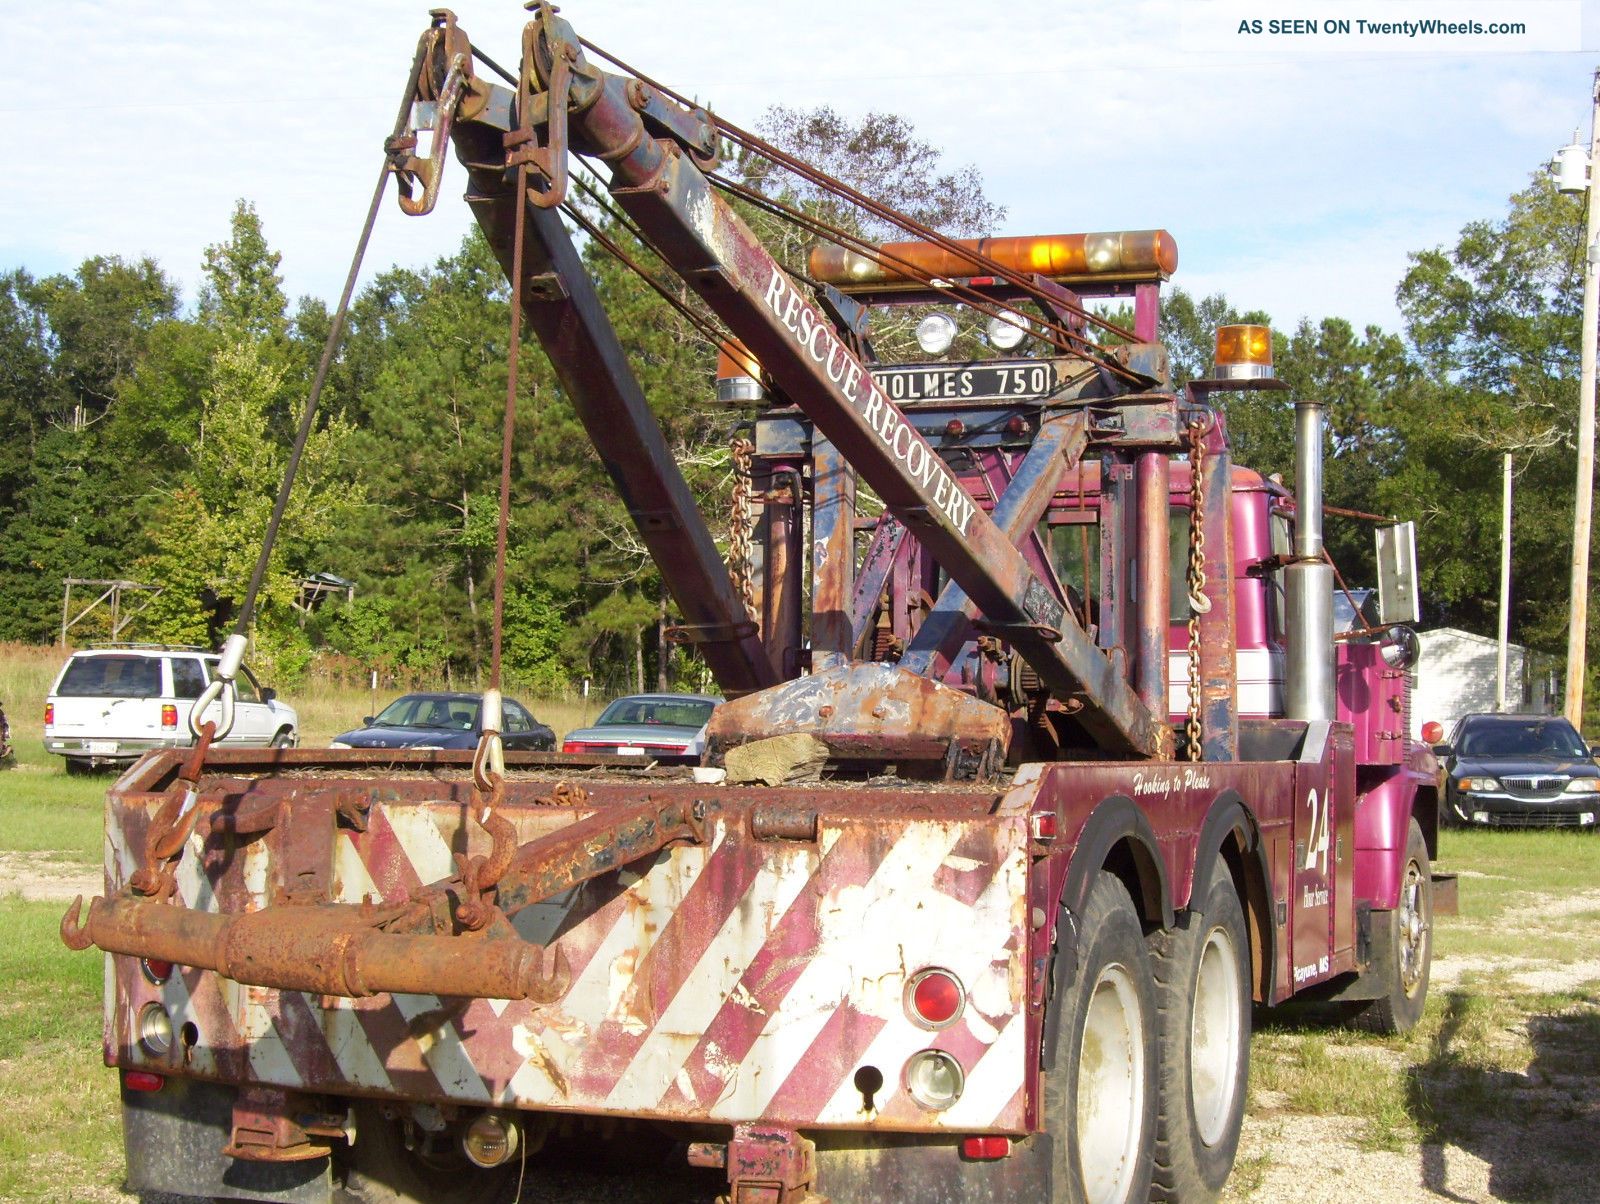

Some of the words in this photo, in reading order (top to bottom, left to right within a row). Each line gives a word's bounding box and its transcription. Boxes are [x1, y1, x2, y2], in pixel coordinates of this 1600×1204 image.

[764, 266, 861, 402] RESCUE
[863, 394, 976, 537] RECOVERY
[876, 373, 973, 398] HOLMES
[997, 368, 1044, 394] 750
[1133, 772, 1171, 800] Hooking
[1173, 775, 1181, 793] to
[1184, 769, 1210, 793] Please
[1305, 787, 1330, 876] 24
